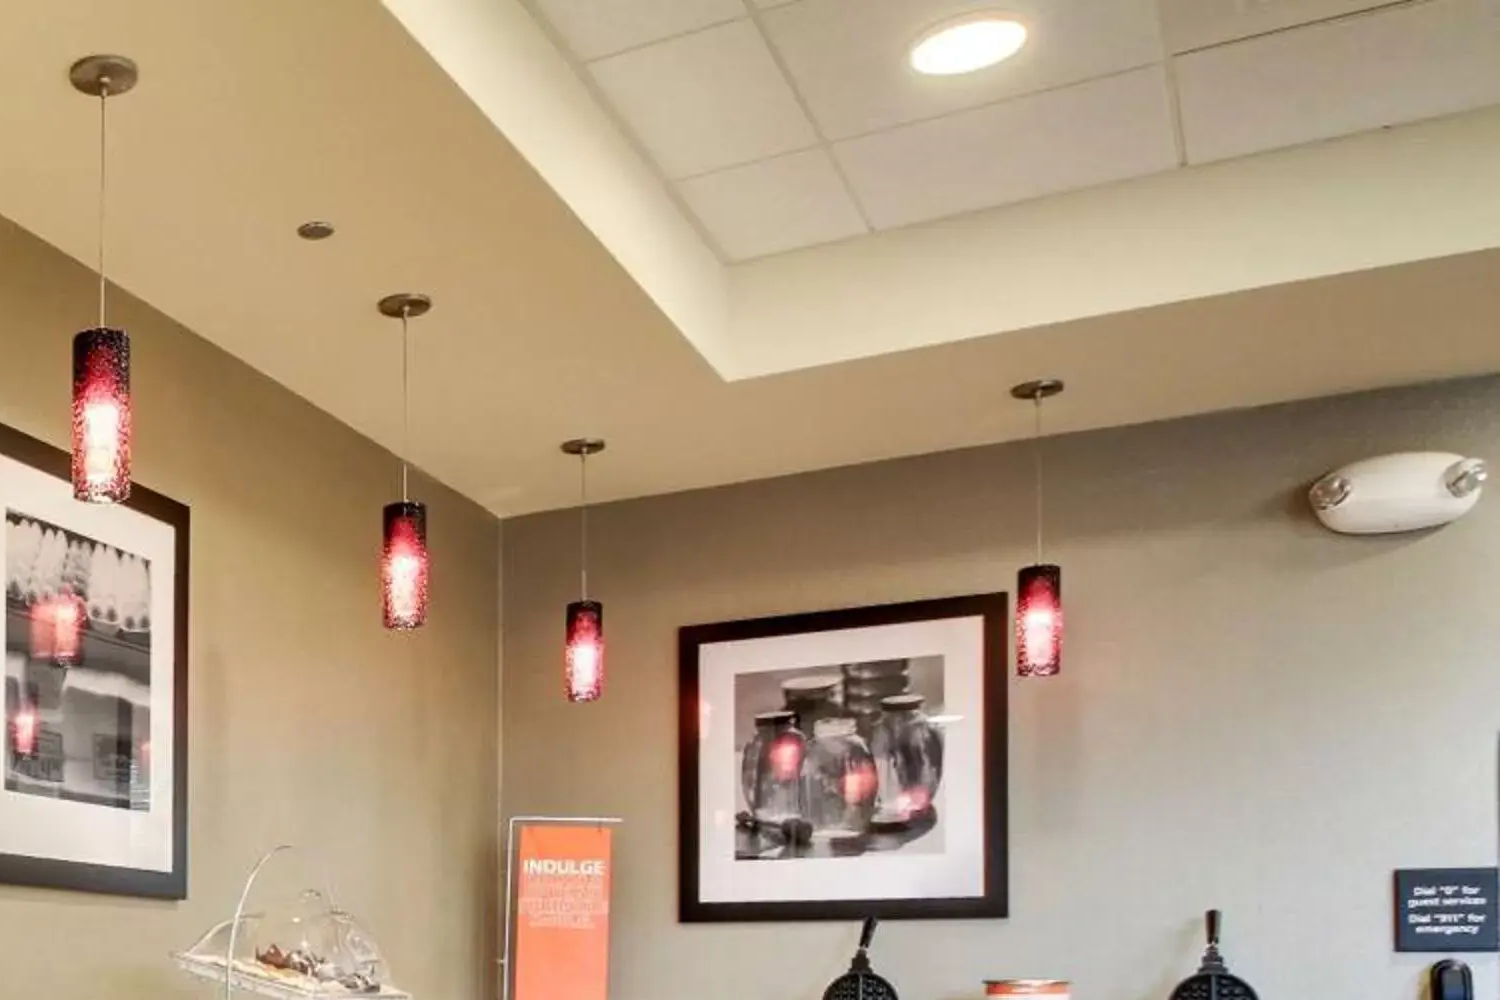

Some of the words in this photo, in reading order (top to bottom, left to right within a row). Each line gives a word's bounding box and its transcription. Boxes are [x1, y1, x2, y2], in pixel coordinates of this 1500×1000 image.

[523, 859, 607, 876] INDULGE
[1413, 886, 1437, 896] Dial
[1462, 885, 1481, 895] for
[1407, 898, 1440, 909] guest
[1442, 896, 1487, 905] services
[1408, 913, 1431, 923] Dial
[1467, 913, 1487, 923] for
[1415, 925, 1480, 935] emergency
